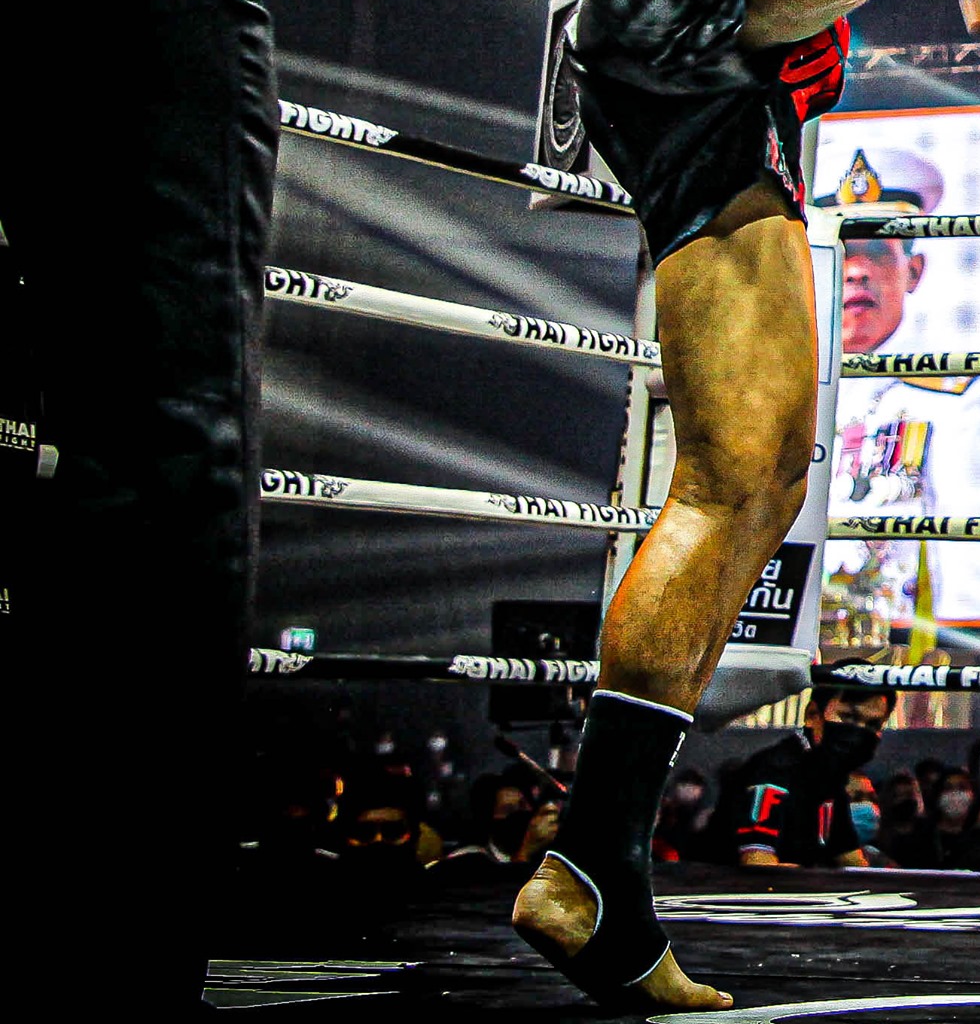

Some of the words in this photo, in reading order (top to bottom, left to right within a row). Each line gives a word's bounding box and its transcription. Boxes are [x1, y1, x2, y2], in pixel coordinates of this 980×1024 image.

[278, 99, 377, 141] FIGHT
[264, 269, 322, 298] GHT
[876, 352, 950, 372] THAI
[261, 469, 320, 496] GHT
[876, 516, 950, 534] THAI
[541, 659, 600, 682] FIGH
[873, 664, 950, 687] THAI
